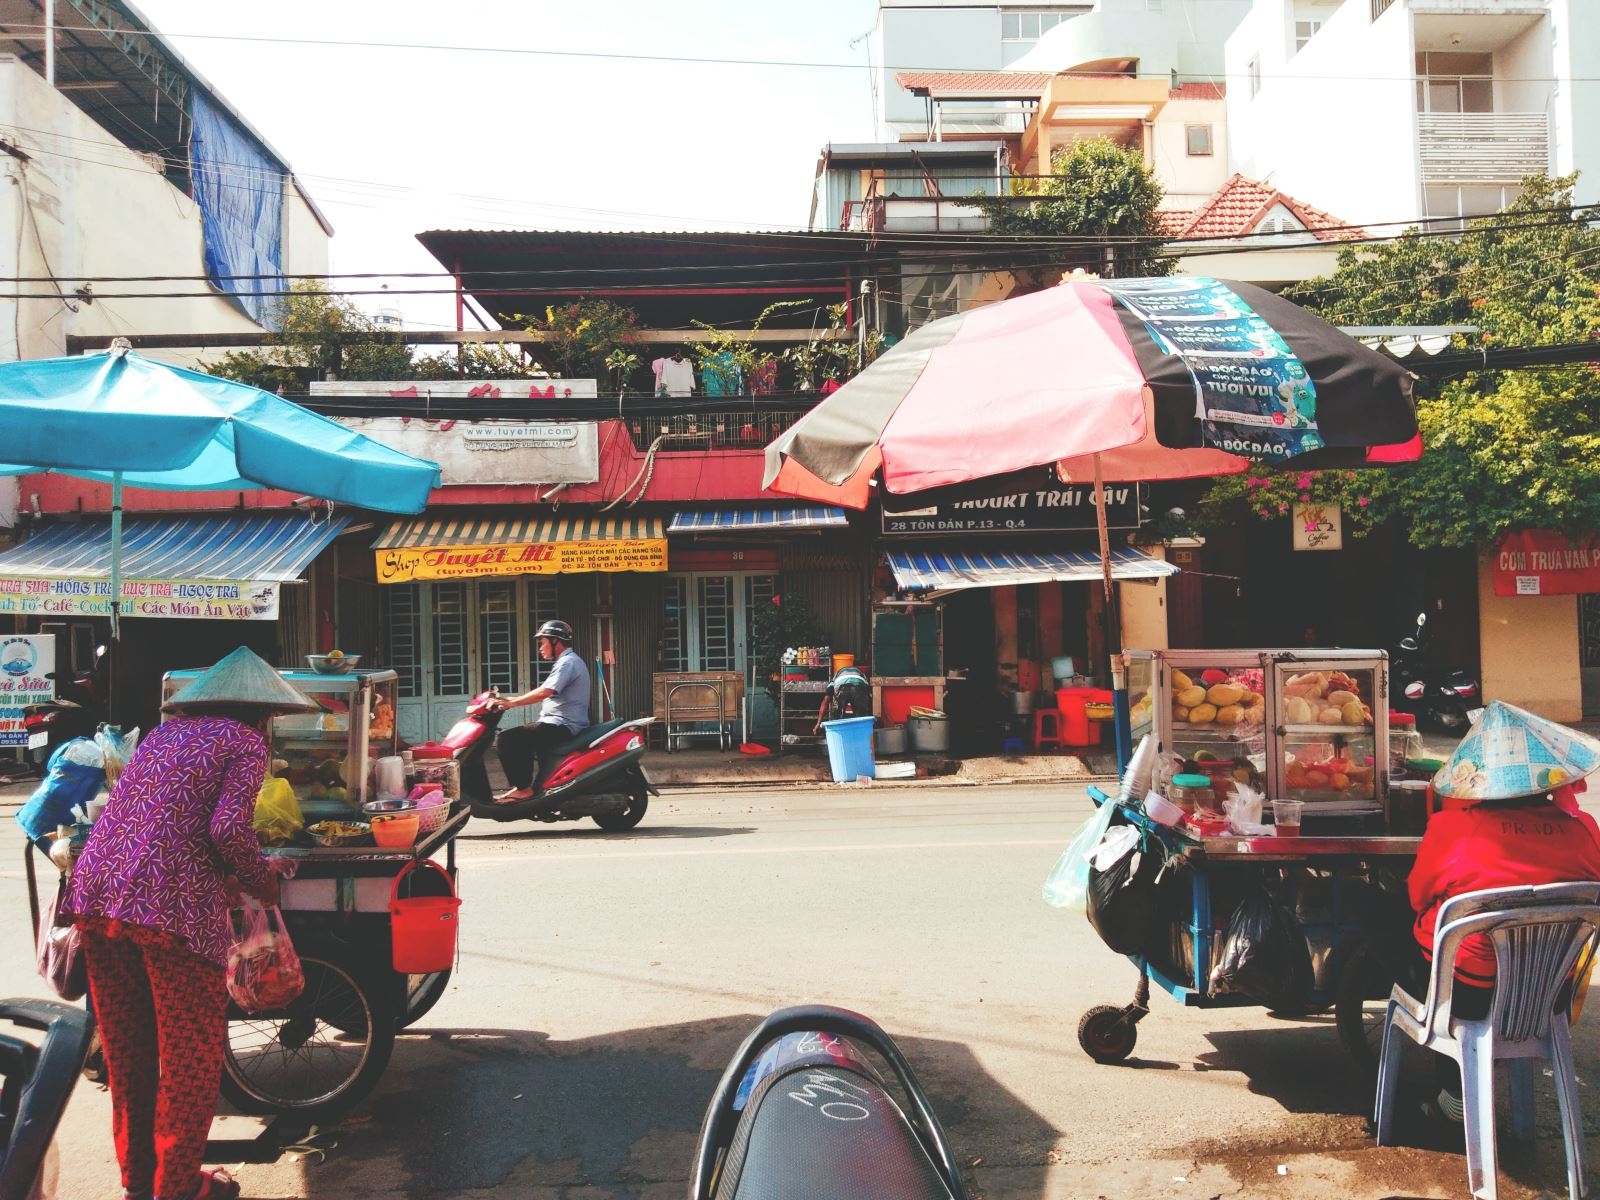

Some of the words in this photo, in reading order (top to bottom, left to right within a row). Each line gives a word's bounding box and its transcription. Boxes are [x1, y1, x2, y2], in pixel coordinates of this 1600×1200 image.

[1036, 487, 1082, 507] TRÁI
[890, 521, 907, 530] 28
[910, 520, 935, 530] TÔN
[967, 520, 994, 529] P.13
[1005, 519, 1026, 528] Q.4
[382, 551, 420, 578] Shop
[423, 548, 509, 567] Tuyết
[512, 544, 556, 562] Mi
[732, 551, 744, 560] 30
